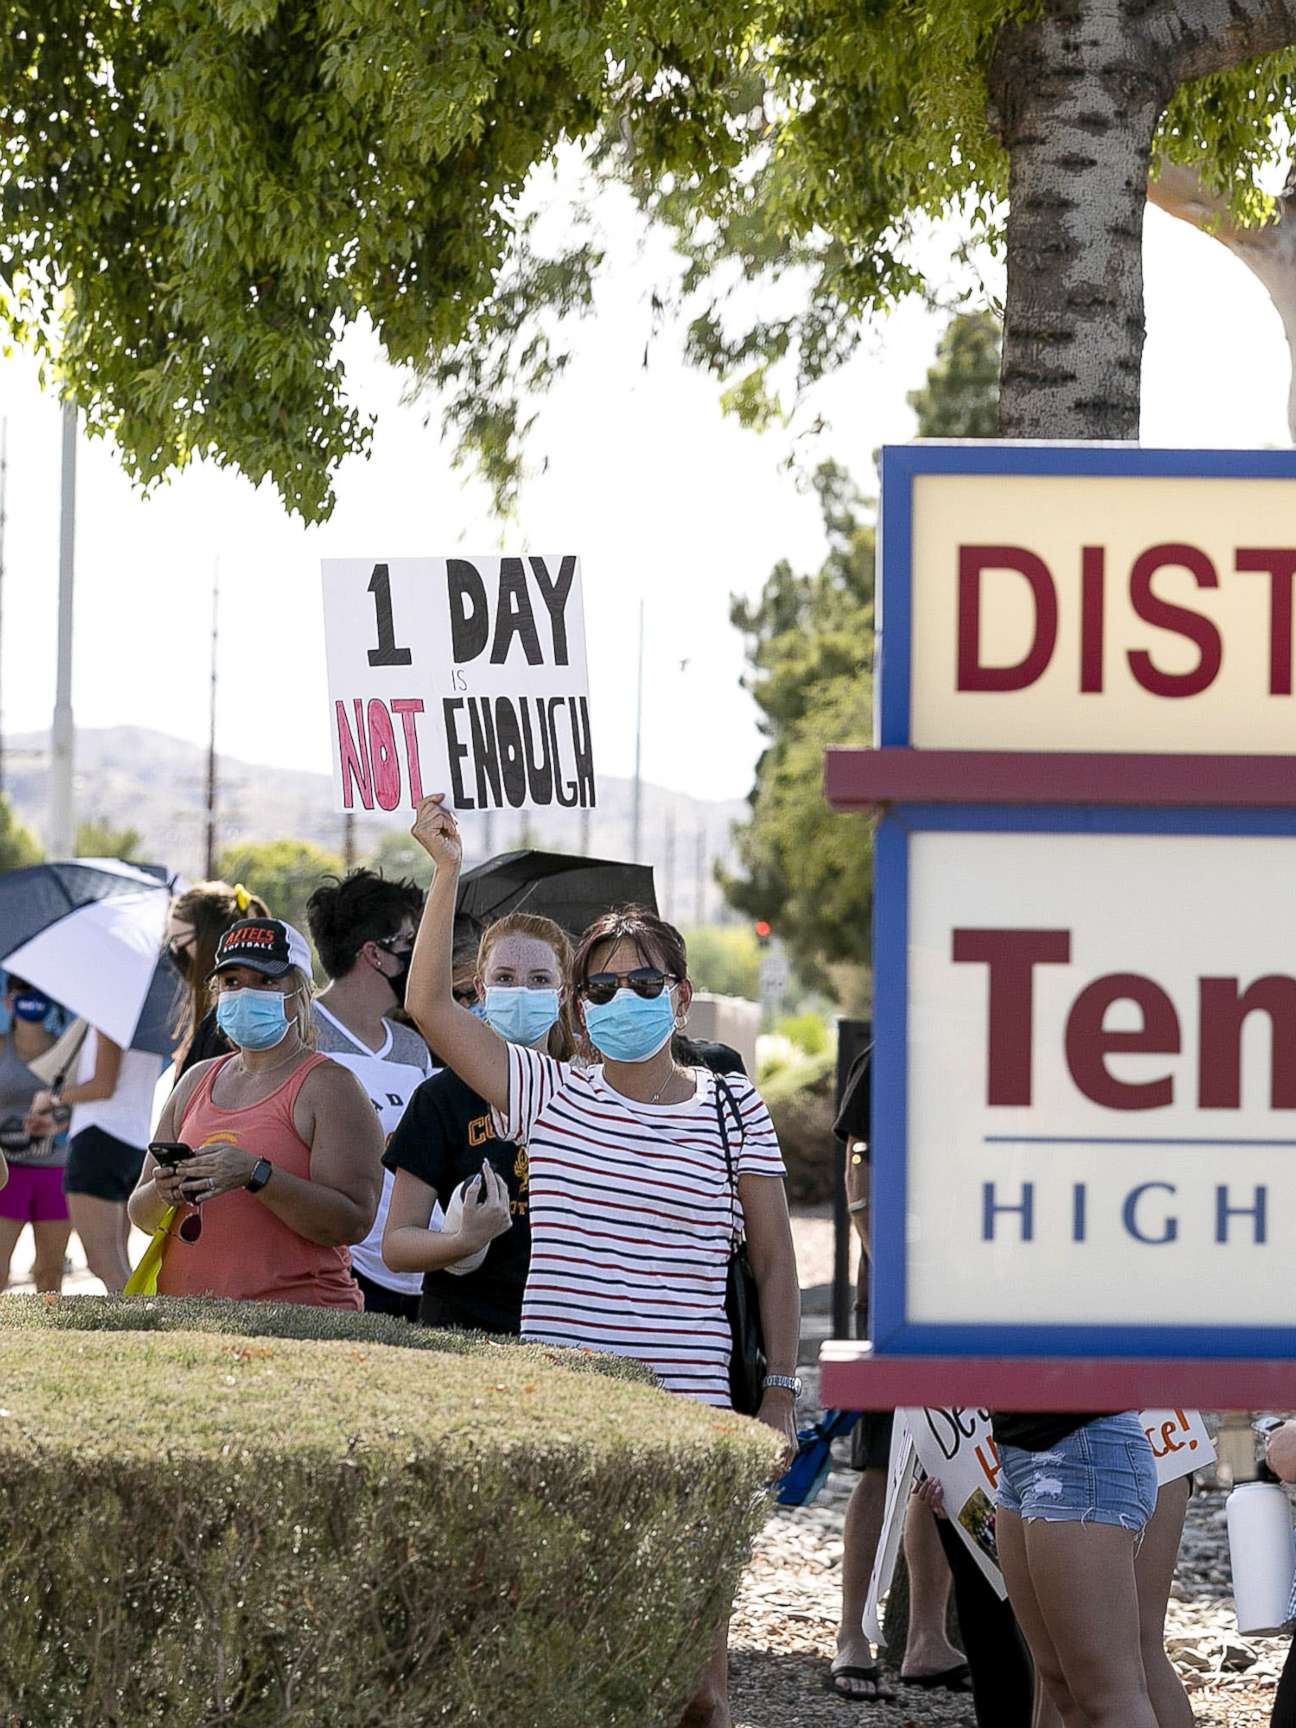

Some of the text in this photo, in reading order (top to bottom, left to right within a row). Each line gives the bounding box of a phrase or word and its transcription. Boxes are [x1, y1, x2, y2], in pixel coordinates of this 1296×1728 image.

[367, 556, 576, 666] 1 DAY
[452, 669, 468, 691] IS
[336, 696, 596, 811] NOT ENOUGH
[225, 927, 274, 945] AZTECS
[983, 1183, 1268, 1244] HIGH
